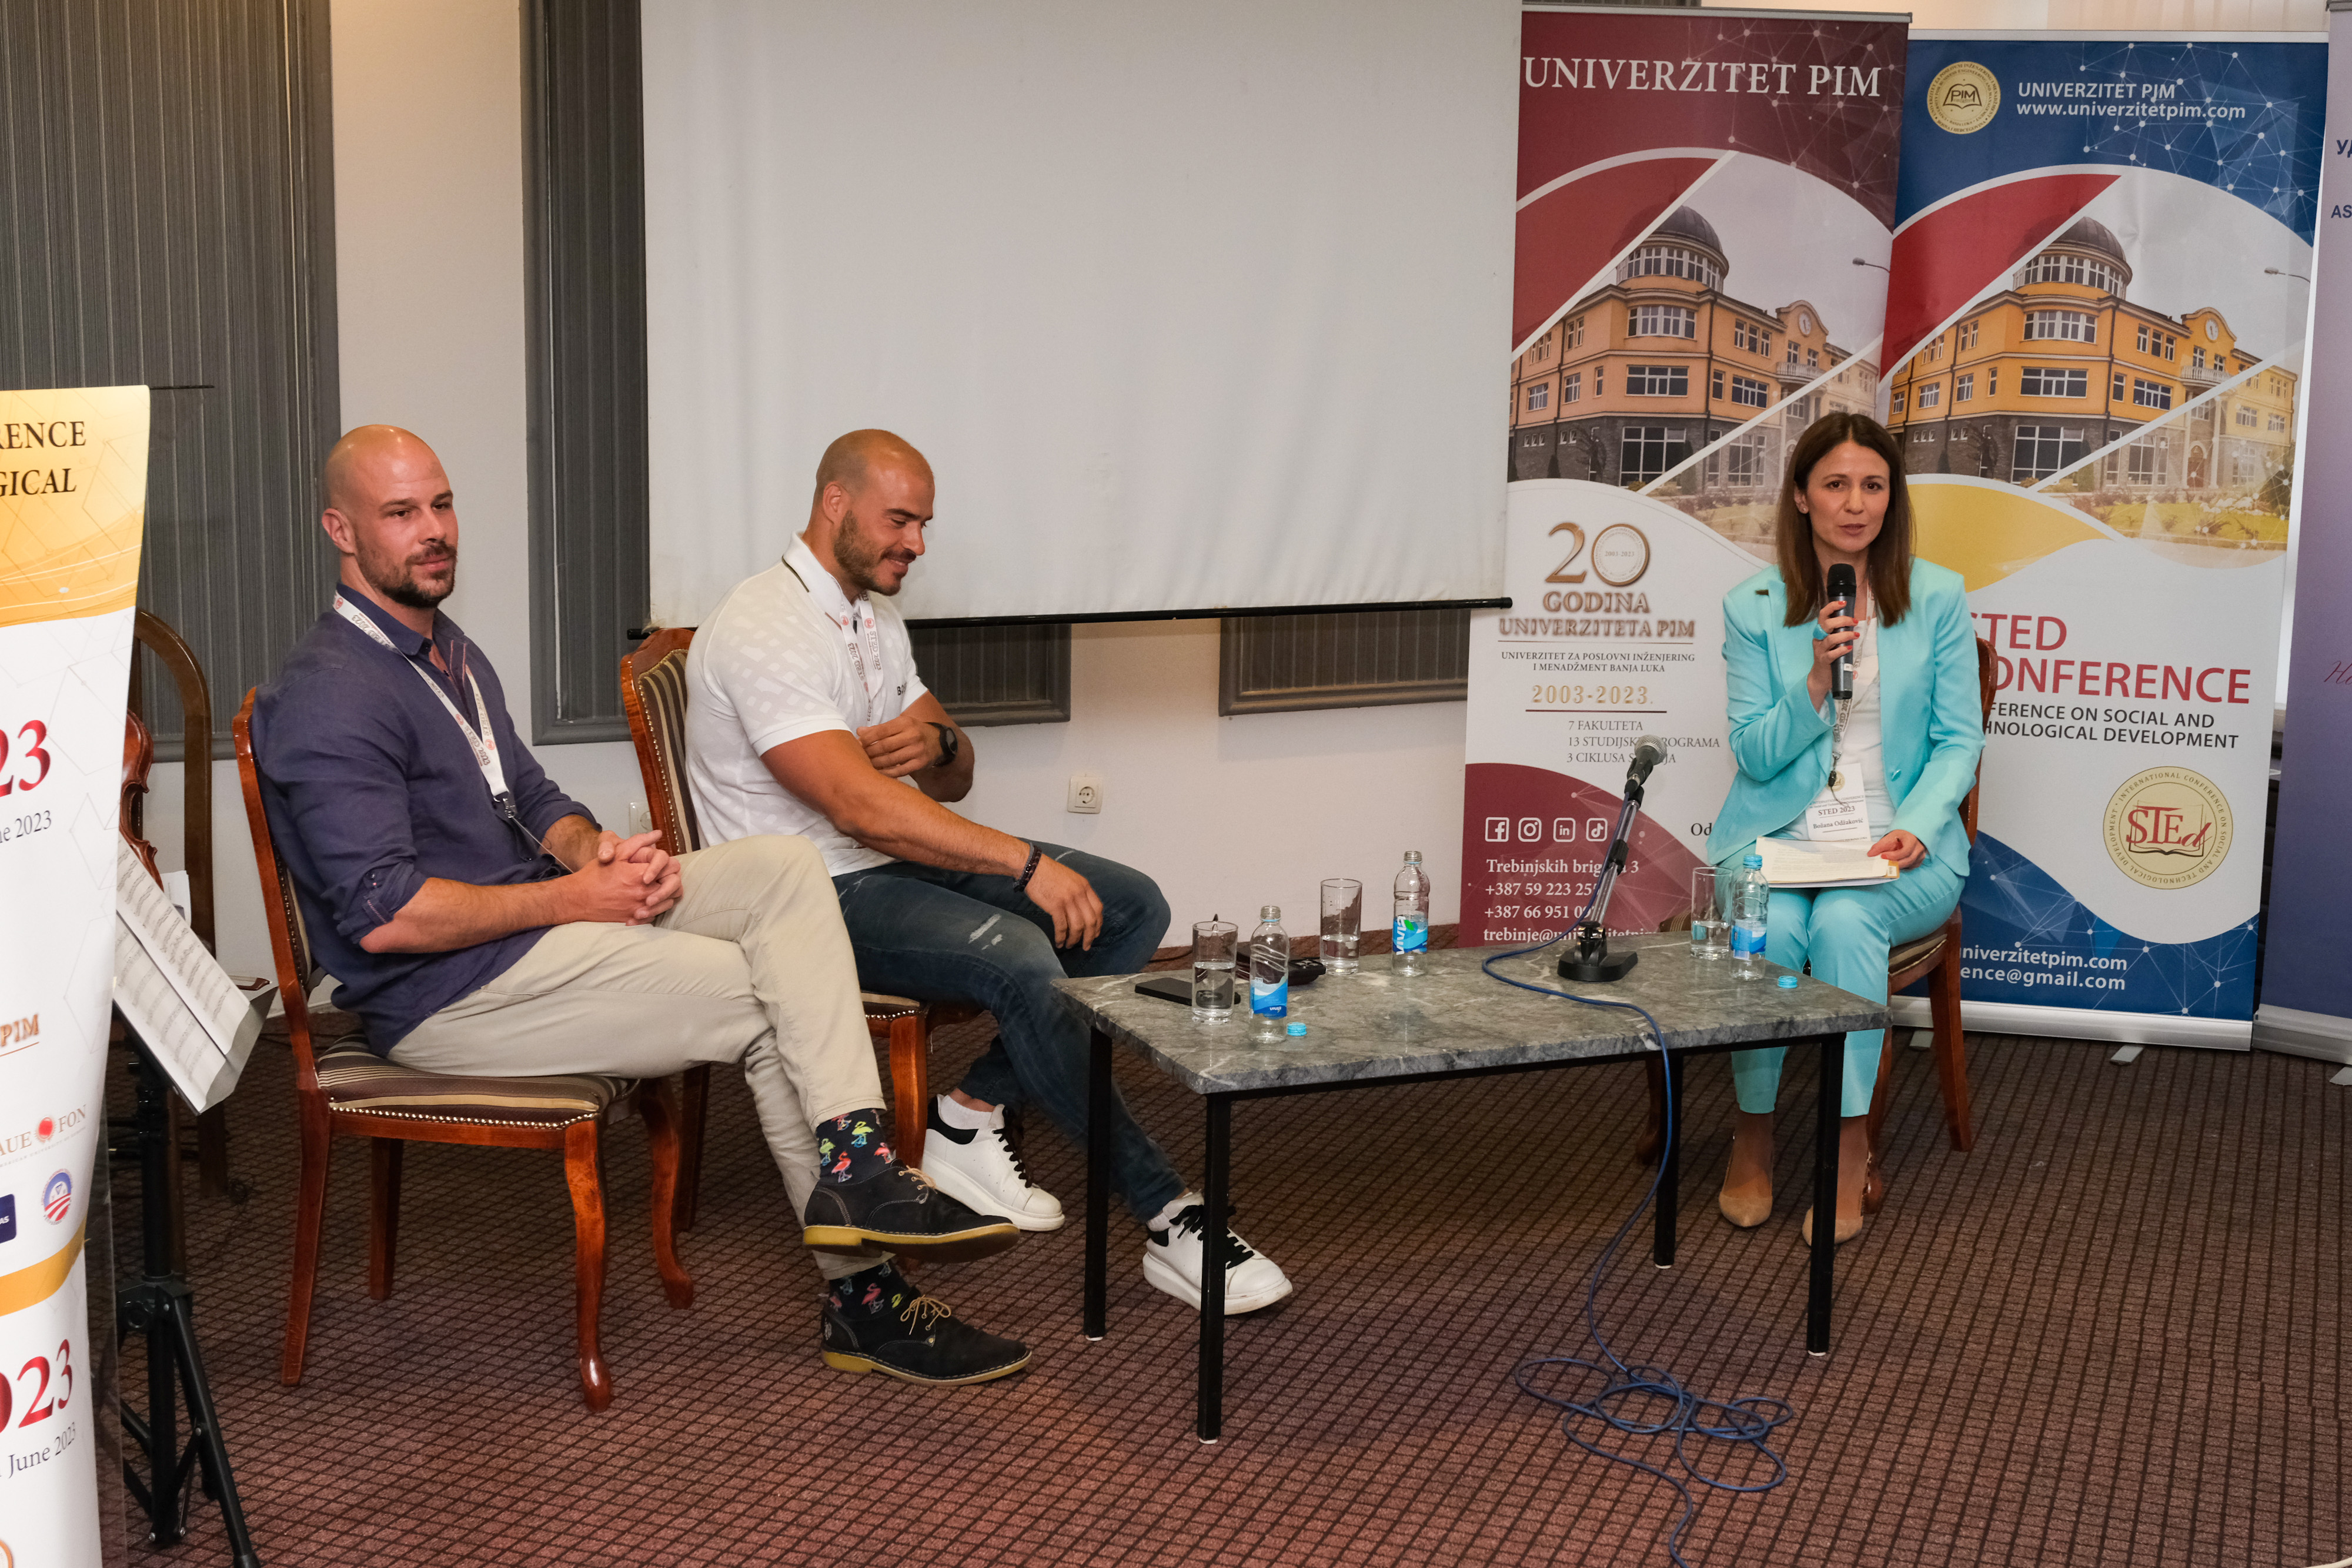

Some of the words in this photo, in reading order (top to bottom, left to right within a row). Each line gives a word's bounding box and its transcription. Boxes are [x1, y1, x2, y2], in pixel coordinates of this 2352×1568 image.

[1523, 57, 1796, 94] UNIVERZITET
[1807, 64, 1881, 97] PIM
[1951, 90, 1976, 102] PIM
[2018, 82, 2137, 98] UNIVERZITET
[2141, 84, 2176, 99] PIM
[2016, 101, 2246, 121] www.univerzitetpim.com
[0, 421, 87, 449] ENCE
[1545, 521, 1651, 587] 20
[1543, 591, 1651, 613] GODINA
[1499, 618, 1652, 637] UNIVERZITETA
[1656, 619, 1696, 638] PIM
[1970, 612, 2067, 651] TED
[848, 642, 858, 660] 2023
[870, 631, 878, 653] STED
[1502, 651, 1565, 660] UNIVERZITET
[1582, 653, 1631, 661] POSLOVNI
[1633, 652, 1695, 662] INŽENJERING
[1539, 662, 1607, 672] MENADŽMENT
[1610, 664, 1638, 673] BANJA
[1641, 664, 1665, 673] LUKA
[1532, 685, 1653, 704] 2003-2023.
[1568, 721, 1575, 730] 7
[1578, 721, 1643, 731] FAKULTETA
[2071, 707, 2097, 721] ON
[2104, 708, 2169, 726] SOCIAL
[2174, 713, 2214, 728] AND
[1569, 737, 1579, 747] 13
[1661, 737, 1720, 748] ROGRAMA
[2104, 727, 2239, 748] DEVELOPMENT
[478, 747, 490, 766] 2023
[1567, 753, 1573, 763] 3
[1576, 753, 1625, 763] CIKLUSA
[2118, 772, 2180, 802] INTERNATIONAL
[2184, 774, 2225, 814] CONFERENCE
[1818, 808, 1838, 816] STED
[2220, 816, 2227, 828] ON
[15, 810, 52, 838] 2023
[1835, 818, 1863, 827] Odžaković
[2126, 805, 2213, 848] STEd
[2109, 808, 2129, 866] DEVELOPMENT
[2214, 831, 2227, 859] SOCIAL
[1486, 859, 1568, 877] Trebinjskih
[1631, 861, 1639, 873] 3
[2130, 865, 2197, 884] TECHNOLOGICAL
[2199, 859, 2213, 874] AND
[1485, 883, 1521, 896] +387
[1525, 883, 1542, 896] 59
[1545, 883, 1571, 896] 223
[1484, 905, 1521, 918] +387
[1524, 905, 1541, 918] 66
[1545, 905, 1568, 918] 951
[1960, 944, 2127, 971] niverzitetpim.com
[0, 1013, 39, 1048] PIM
[58, 1104, 87, 1133] FON
[8, 1446, 50, 1479] June
[54, 1421, 76, 1456] 2023
